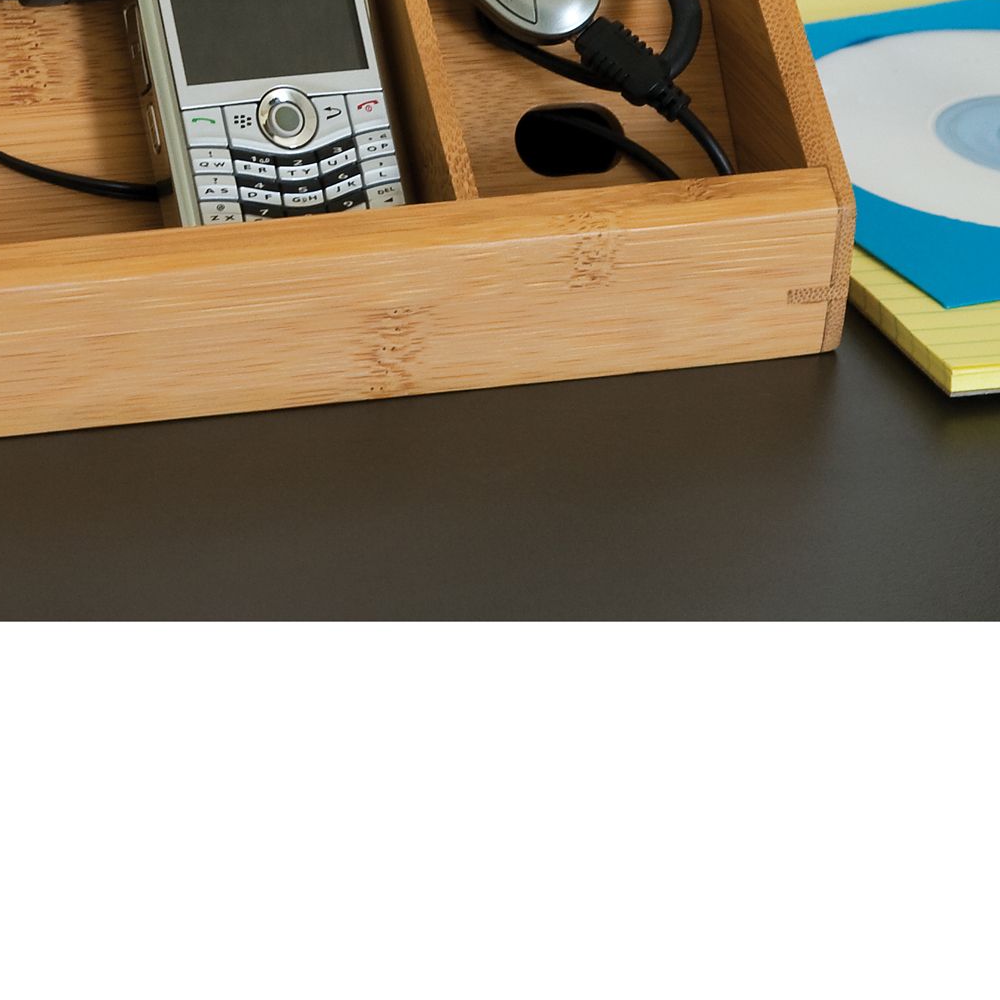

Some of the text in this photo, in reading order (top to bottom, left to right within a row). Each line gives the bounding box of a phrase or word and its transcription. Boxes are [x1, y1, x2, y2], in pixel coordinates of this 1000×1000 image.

[337, 172, 349, 180] 6
[377, 186, 396, 195] DEL
[260, 208, 269, 216] 7
